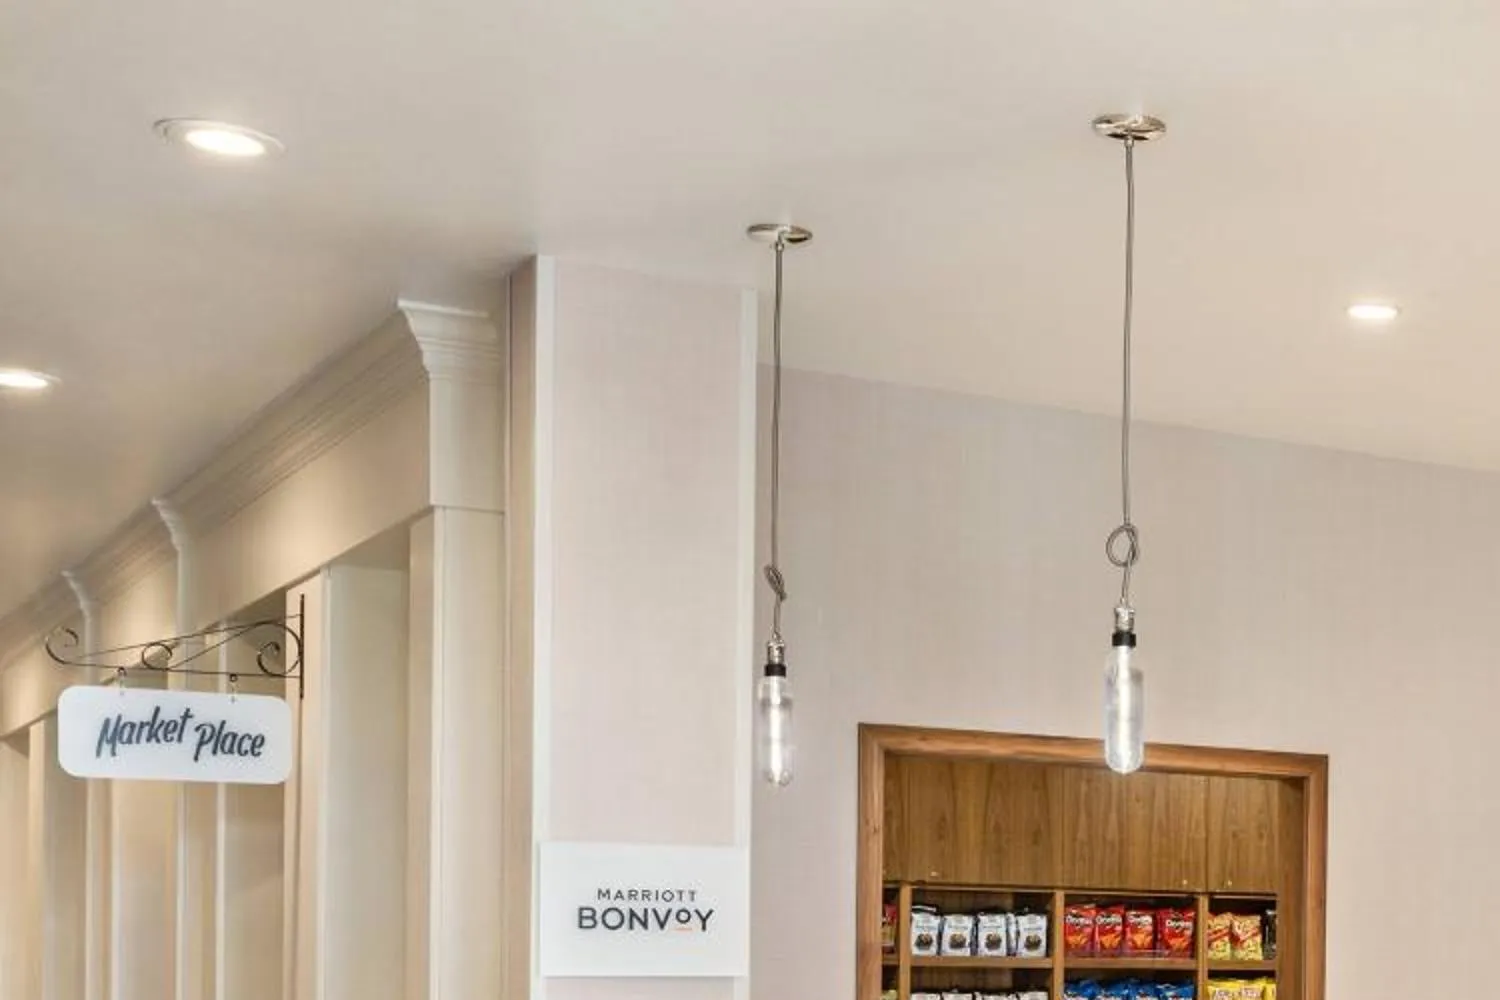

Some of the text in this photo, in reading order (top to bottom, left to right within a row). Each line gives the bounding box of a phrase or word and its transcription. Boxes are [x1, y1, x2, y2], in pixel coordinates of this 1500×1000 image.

[95, 705, 266, 763] Market Place
[597, 888, 697, 902] MARRIOTT
[578, 906, 715, 932] BONVOY
